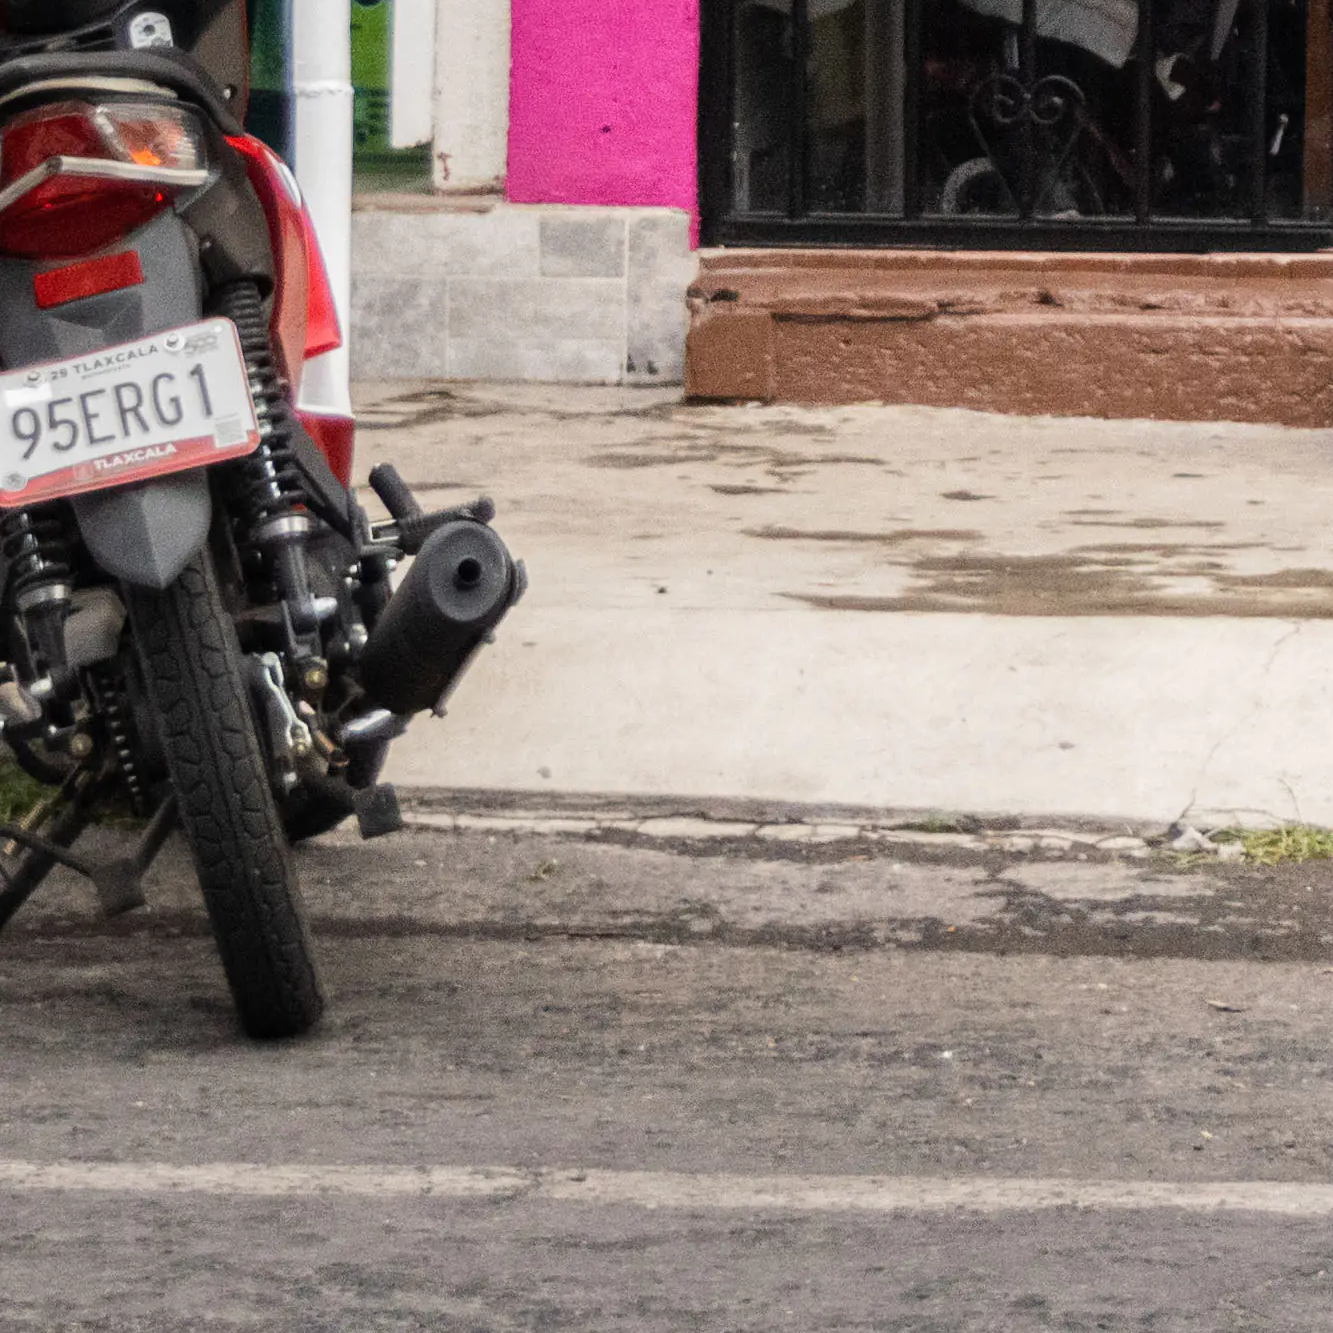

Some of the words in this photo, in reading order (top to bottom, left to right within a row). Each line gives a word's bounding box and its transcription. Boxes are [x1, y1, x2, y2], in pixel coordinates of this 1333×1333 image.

[72, 343, 159, 375] TLAXCALA
[11, 362, 213, 461] 95ERG1
[93, 442, 178, 471] TLAXCALA
